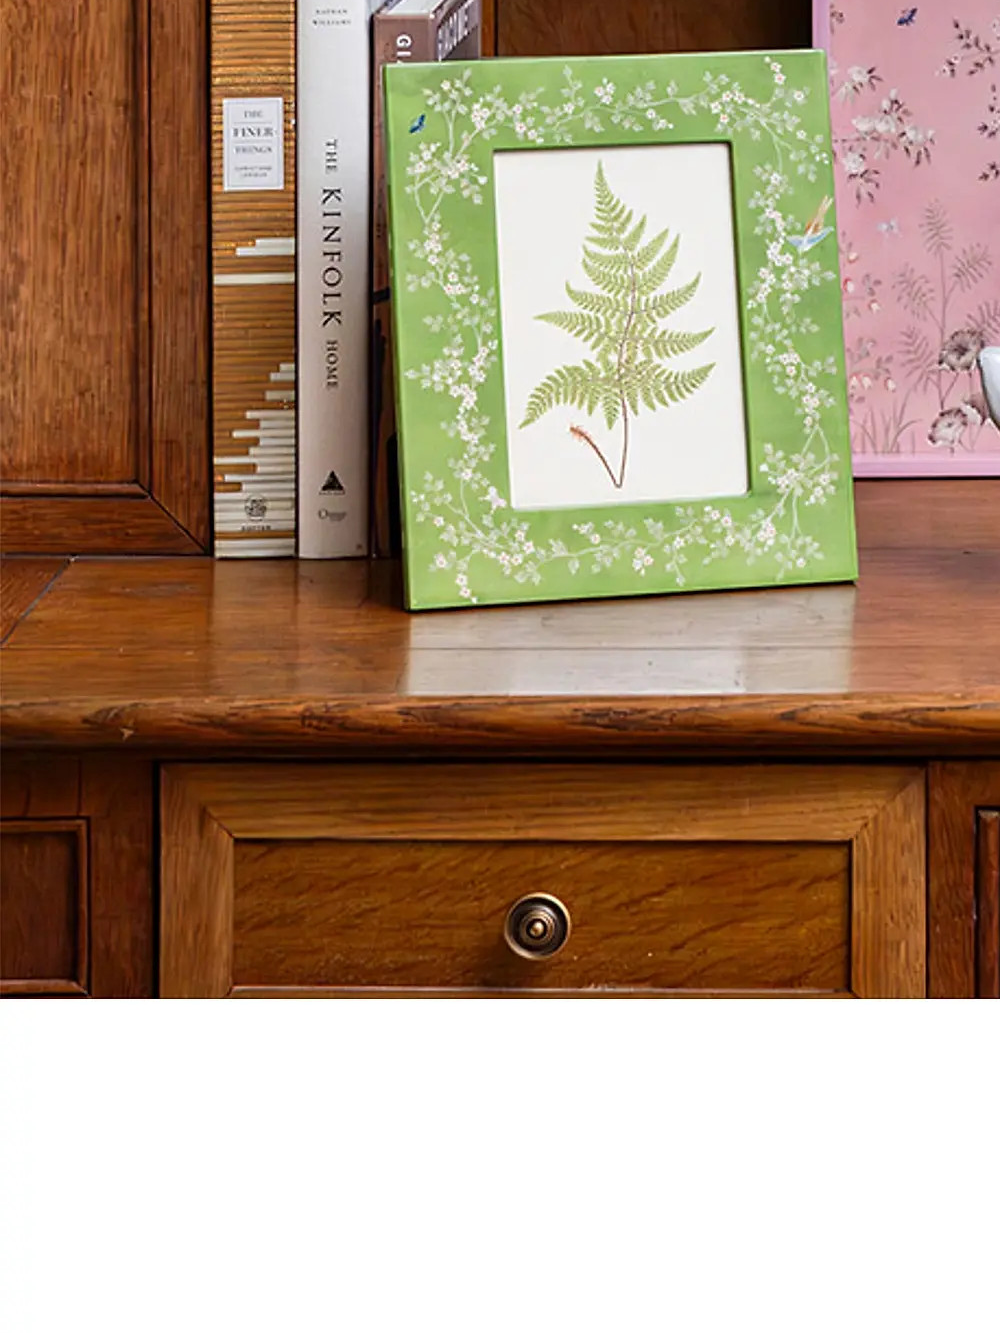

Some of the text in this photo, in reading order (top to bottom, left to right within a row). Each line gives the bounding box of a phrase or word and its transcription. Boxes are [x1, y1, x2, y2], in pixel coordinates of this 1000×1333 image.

[244, 110, 264, 119] THE
[232, 126, 274, 138] FINER
[233, 145, 273, 155] THINGS
[321, 138, 344, 392] THE KINFOLK HOME
